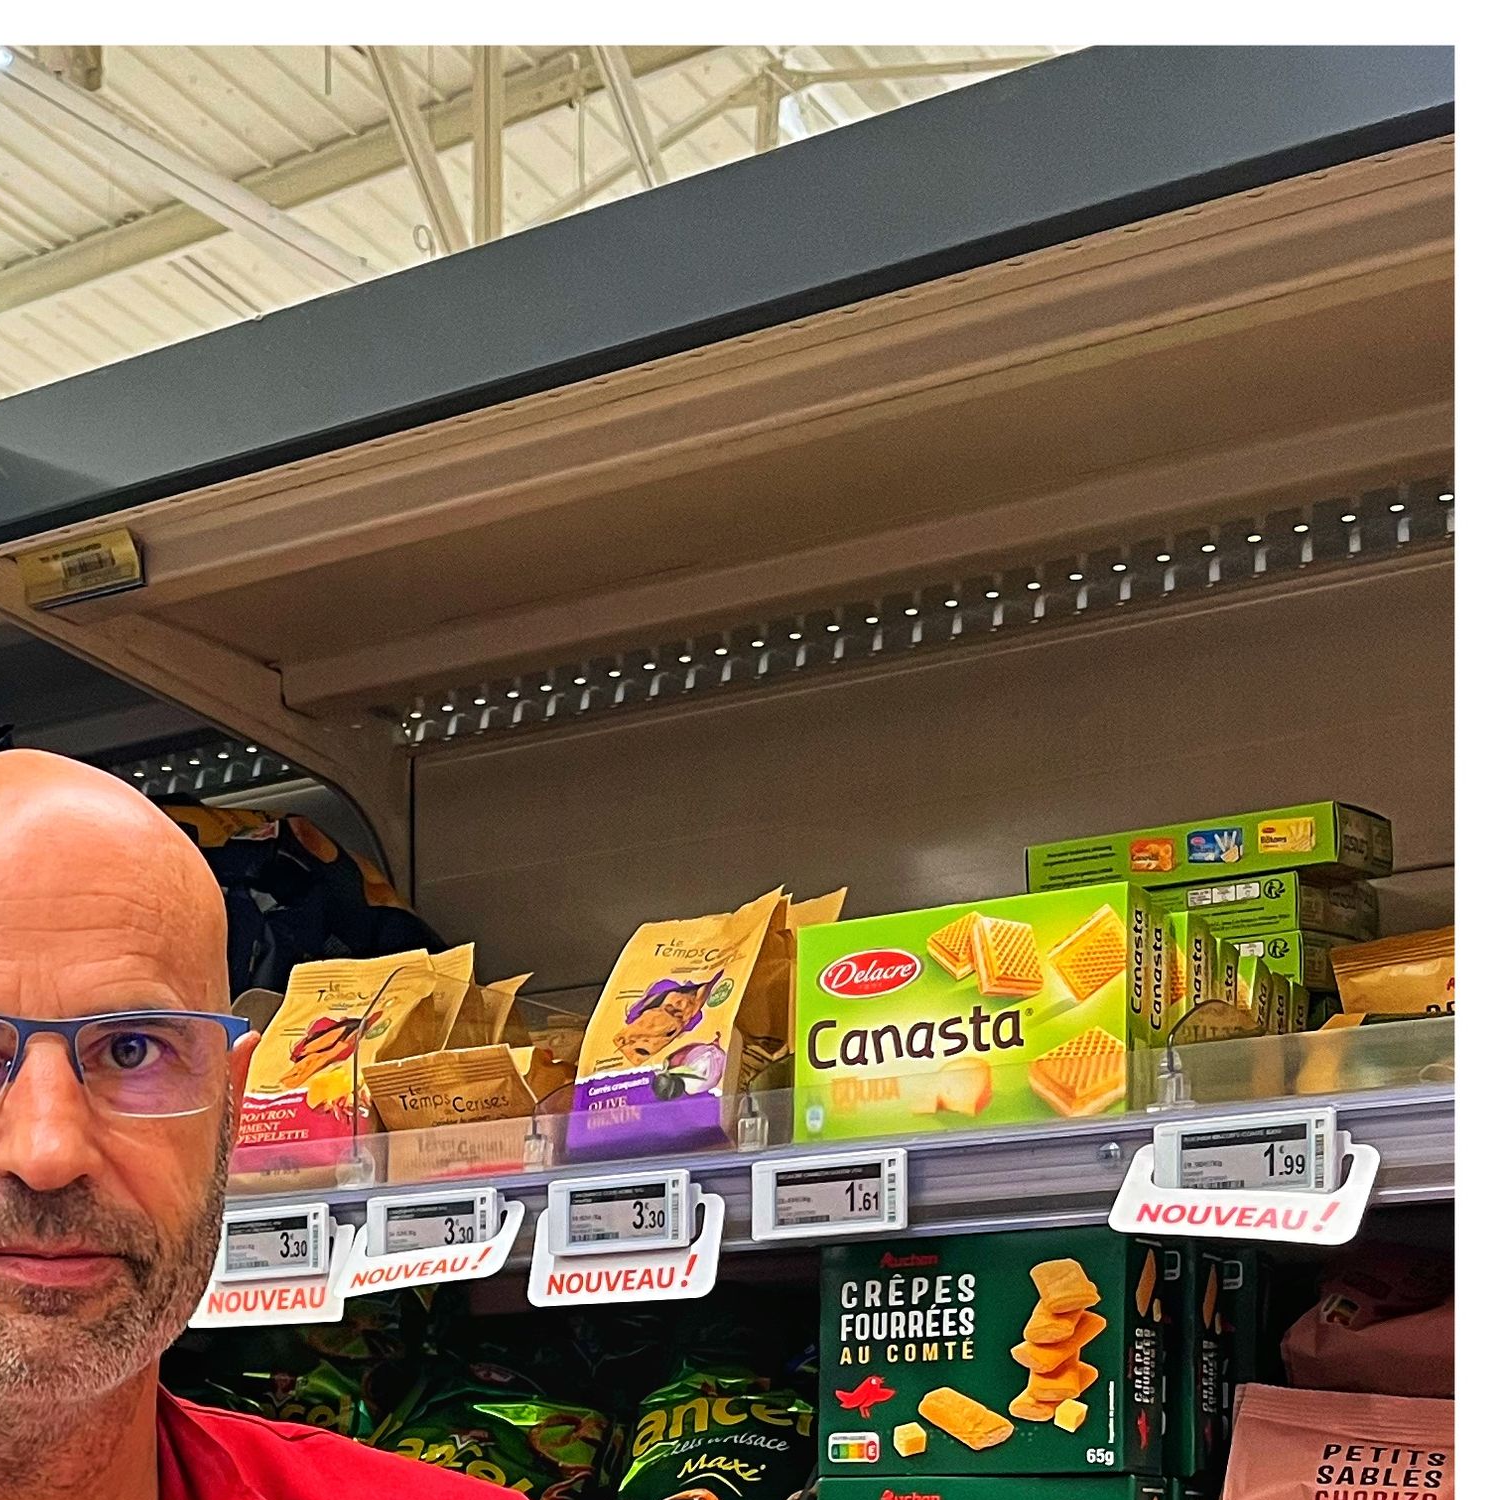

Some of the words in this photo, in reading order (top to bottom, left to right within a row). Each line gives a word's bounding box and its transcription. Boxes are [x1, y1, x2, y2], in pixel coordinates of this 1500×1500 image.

[827, 958, 914, 990] Delacre
[1131, 909, 1143, 1014] Canasta
[1193, 938, 1203, 1006] nasta
[1151, 928, 1162, 1030] Canasta
[807, 1005, 1025, 1070] Canasta
[240, 1108, 298, 1123] POIVRON
[399, 1094, 451, 1111] Temps
[452, 1095, 509, 1112] Cerises
[1135, 1202, 1311, 1233] NOUVEAU
[350, 1256, 469, 1288] NOUVEAU
[879, 1252, 938, 1269] Auchan
[547, 1265, 675, 1296] NOUVEAU
[841, 1273, 975, 1309] CRÊPES
[207, 1287, 327, 1315] NOUVEAU
[841, 1303, 975, 1342] FOURRÉES
[839, 1346, 870, 1366] AU
[886, 1337, 974, 1363] COMTÉ
[676, 1453, 767, 1482] Maxi
[1086, 1449, 1114, 1467] 65g
[1322, 1443, 1447, 1467] PETITS
[1316, 1463, 1443, 1489] SABLÉS
